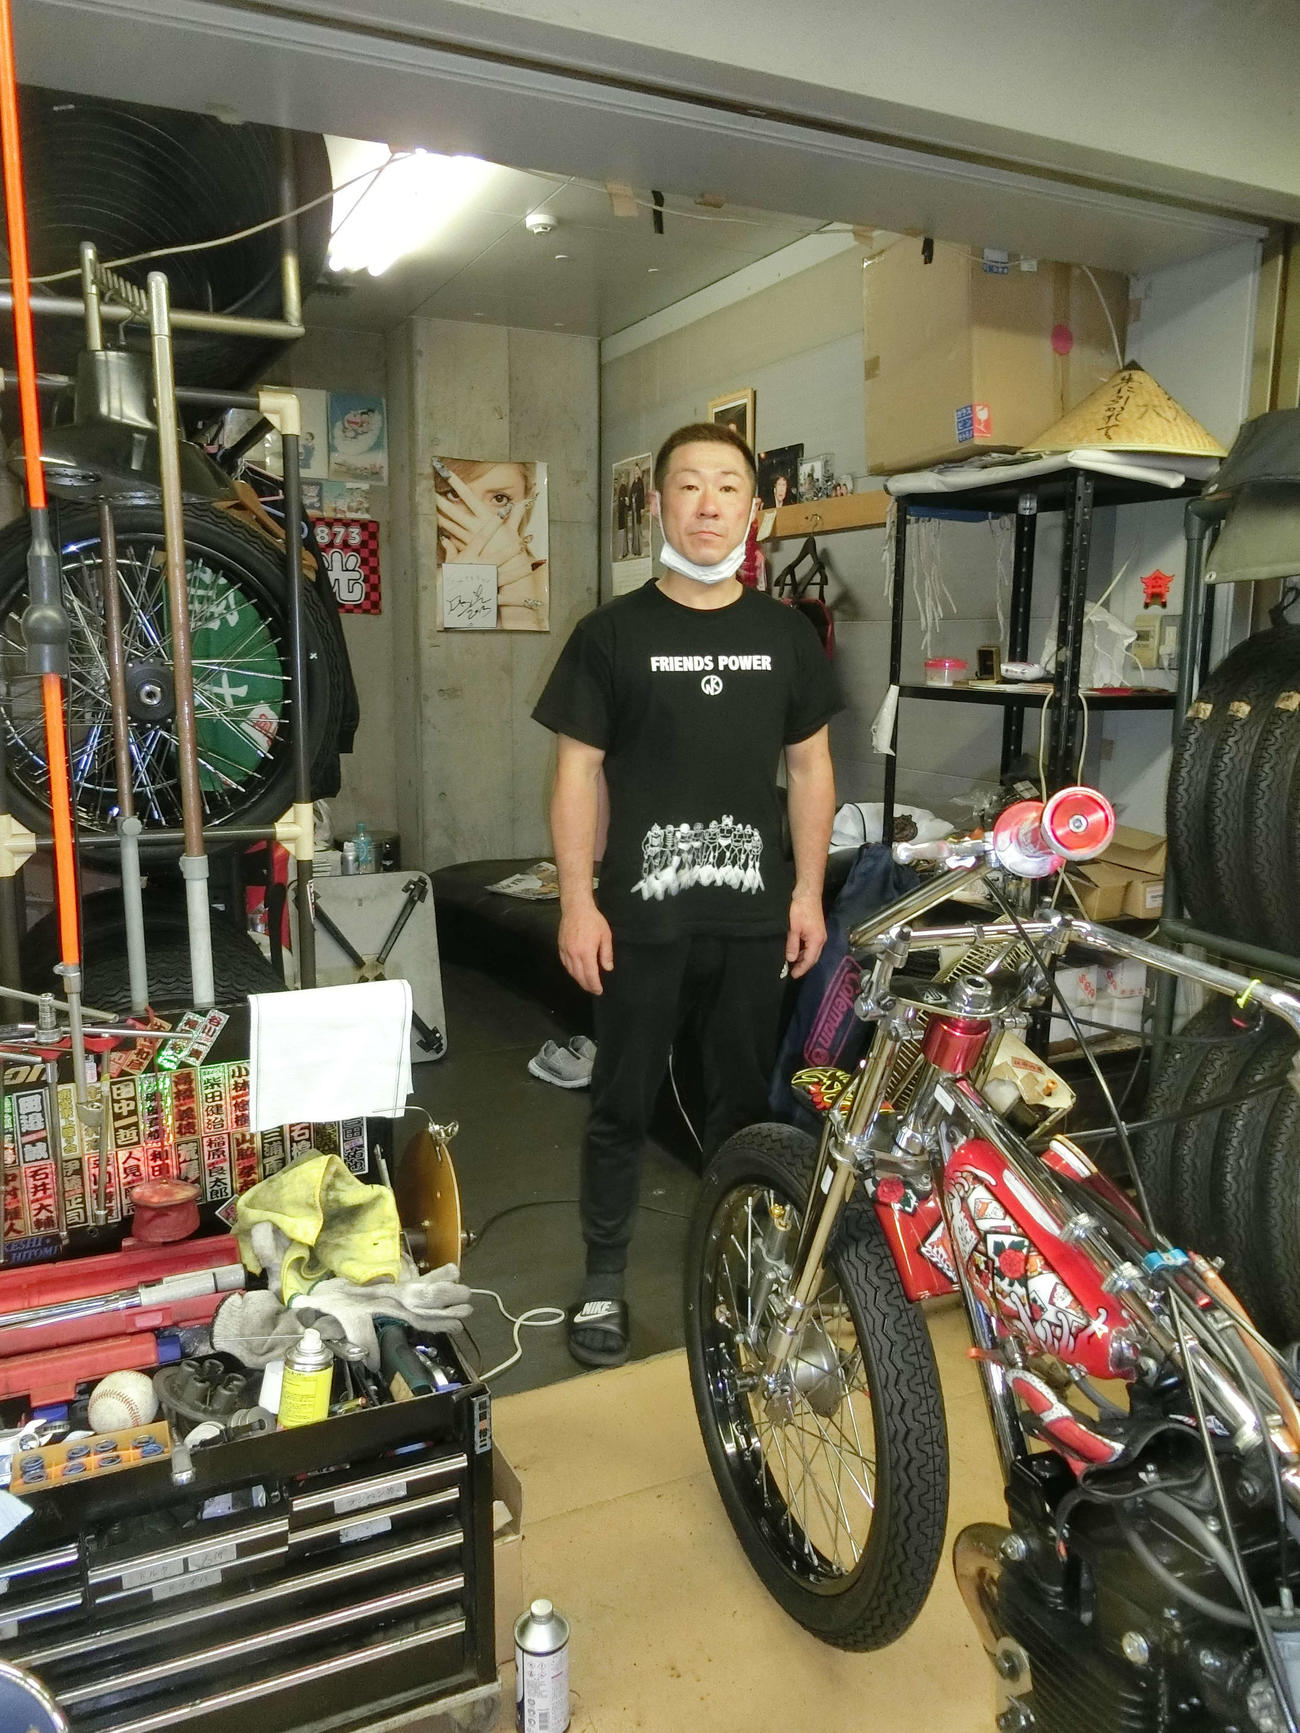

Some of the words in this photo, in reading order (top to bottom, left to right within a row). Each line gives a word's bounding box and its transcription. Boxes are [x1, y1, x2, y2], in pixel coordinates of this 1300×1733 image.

[314, 525, 362, 546] 873
[650, 656, 714, 672] FRIENDS
[717, 655, 772, 671] POWER
[582, 1301, 612, 1315] NIKE
